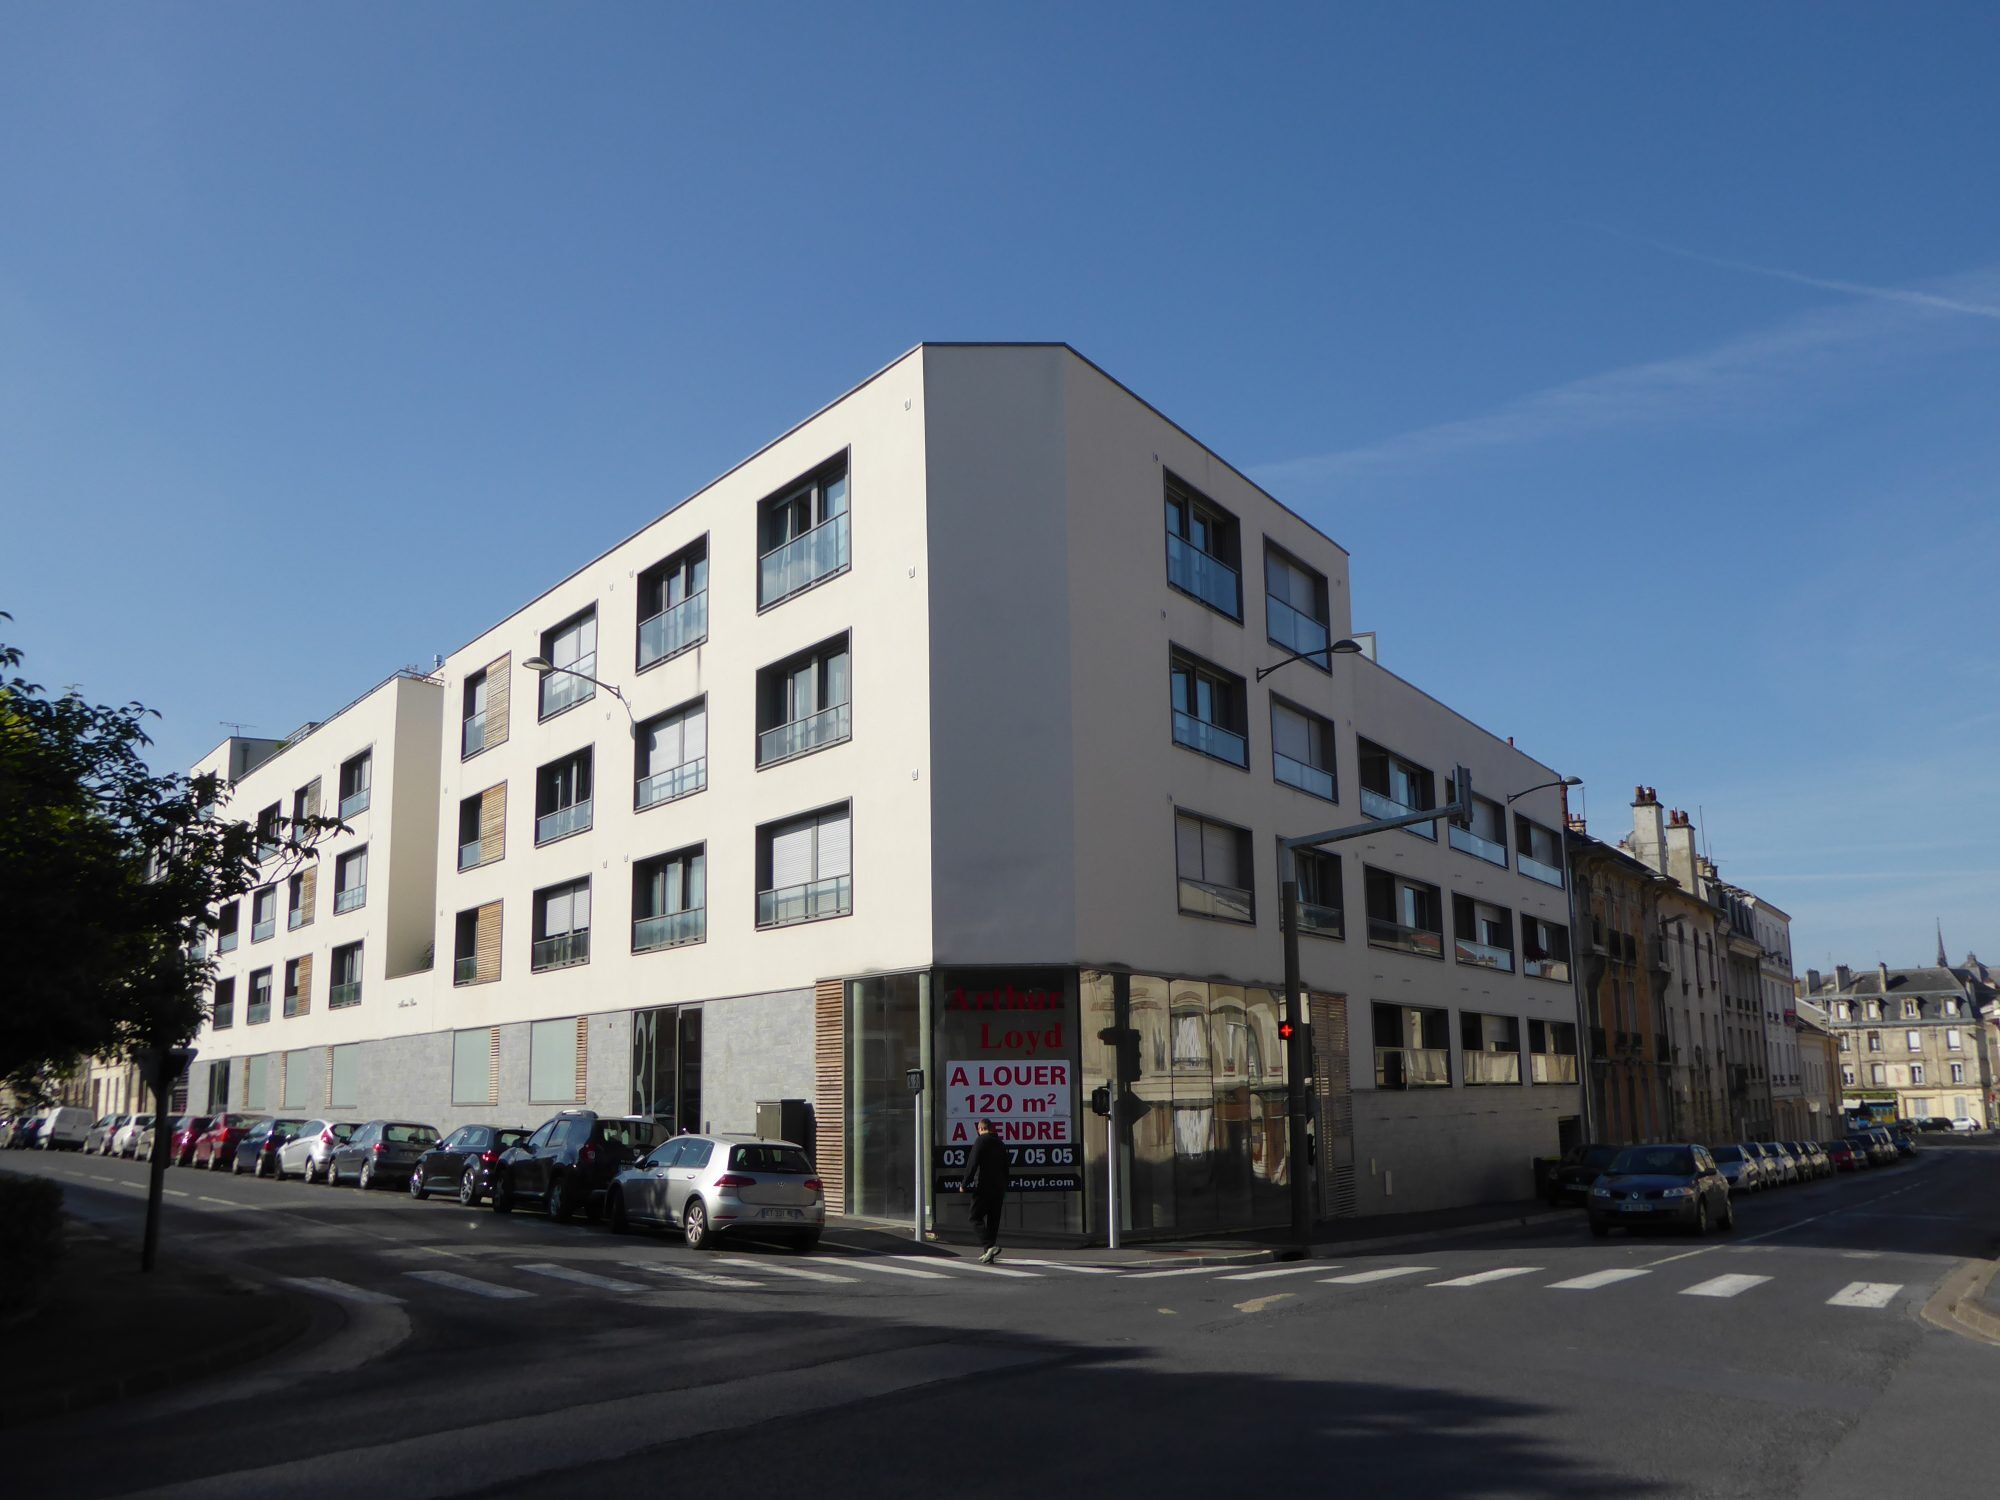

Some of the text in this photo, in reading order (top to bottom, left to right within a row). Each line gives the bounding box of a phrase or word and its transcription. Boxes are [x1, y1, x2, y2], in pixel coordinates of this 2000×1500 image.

[949, 984, 1064, 1011] Arthur
[979, 1023, 1064, 1056] Loyd
[950, 1065, 1067, 1087] A LOUER
[965, 1093, 1013, 1113] 120
[952, 1122, 968, 1141] A
[943, 1149, 965, 1165] 03
[1024, 1148, 1046, 1164] 05
[1051, 1147, 1073, 1163] 05
